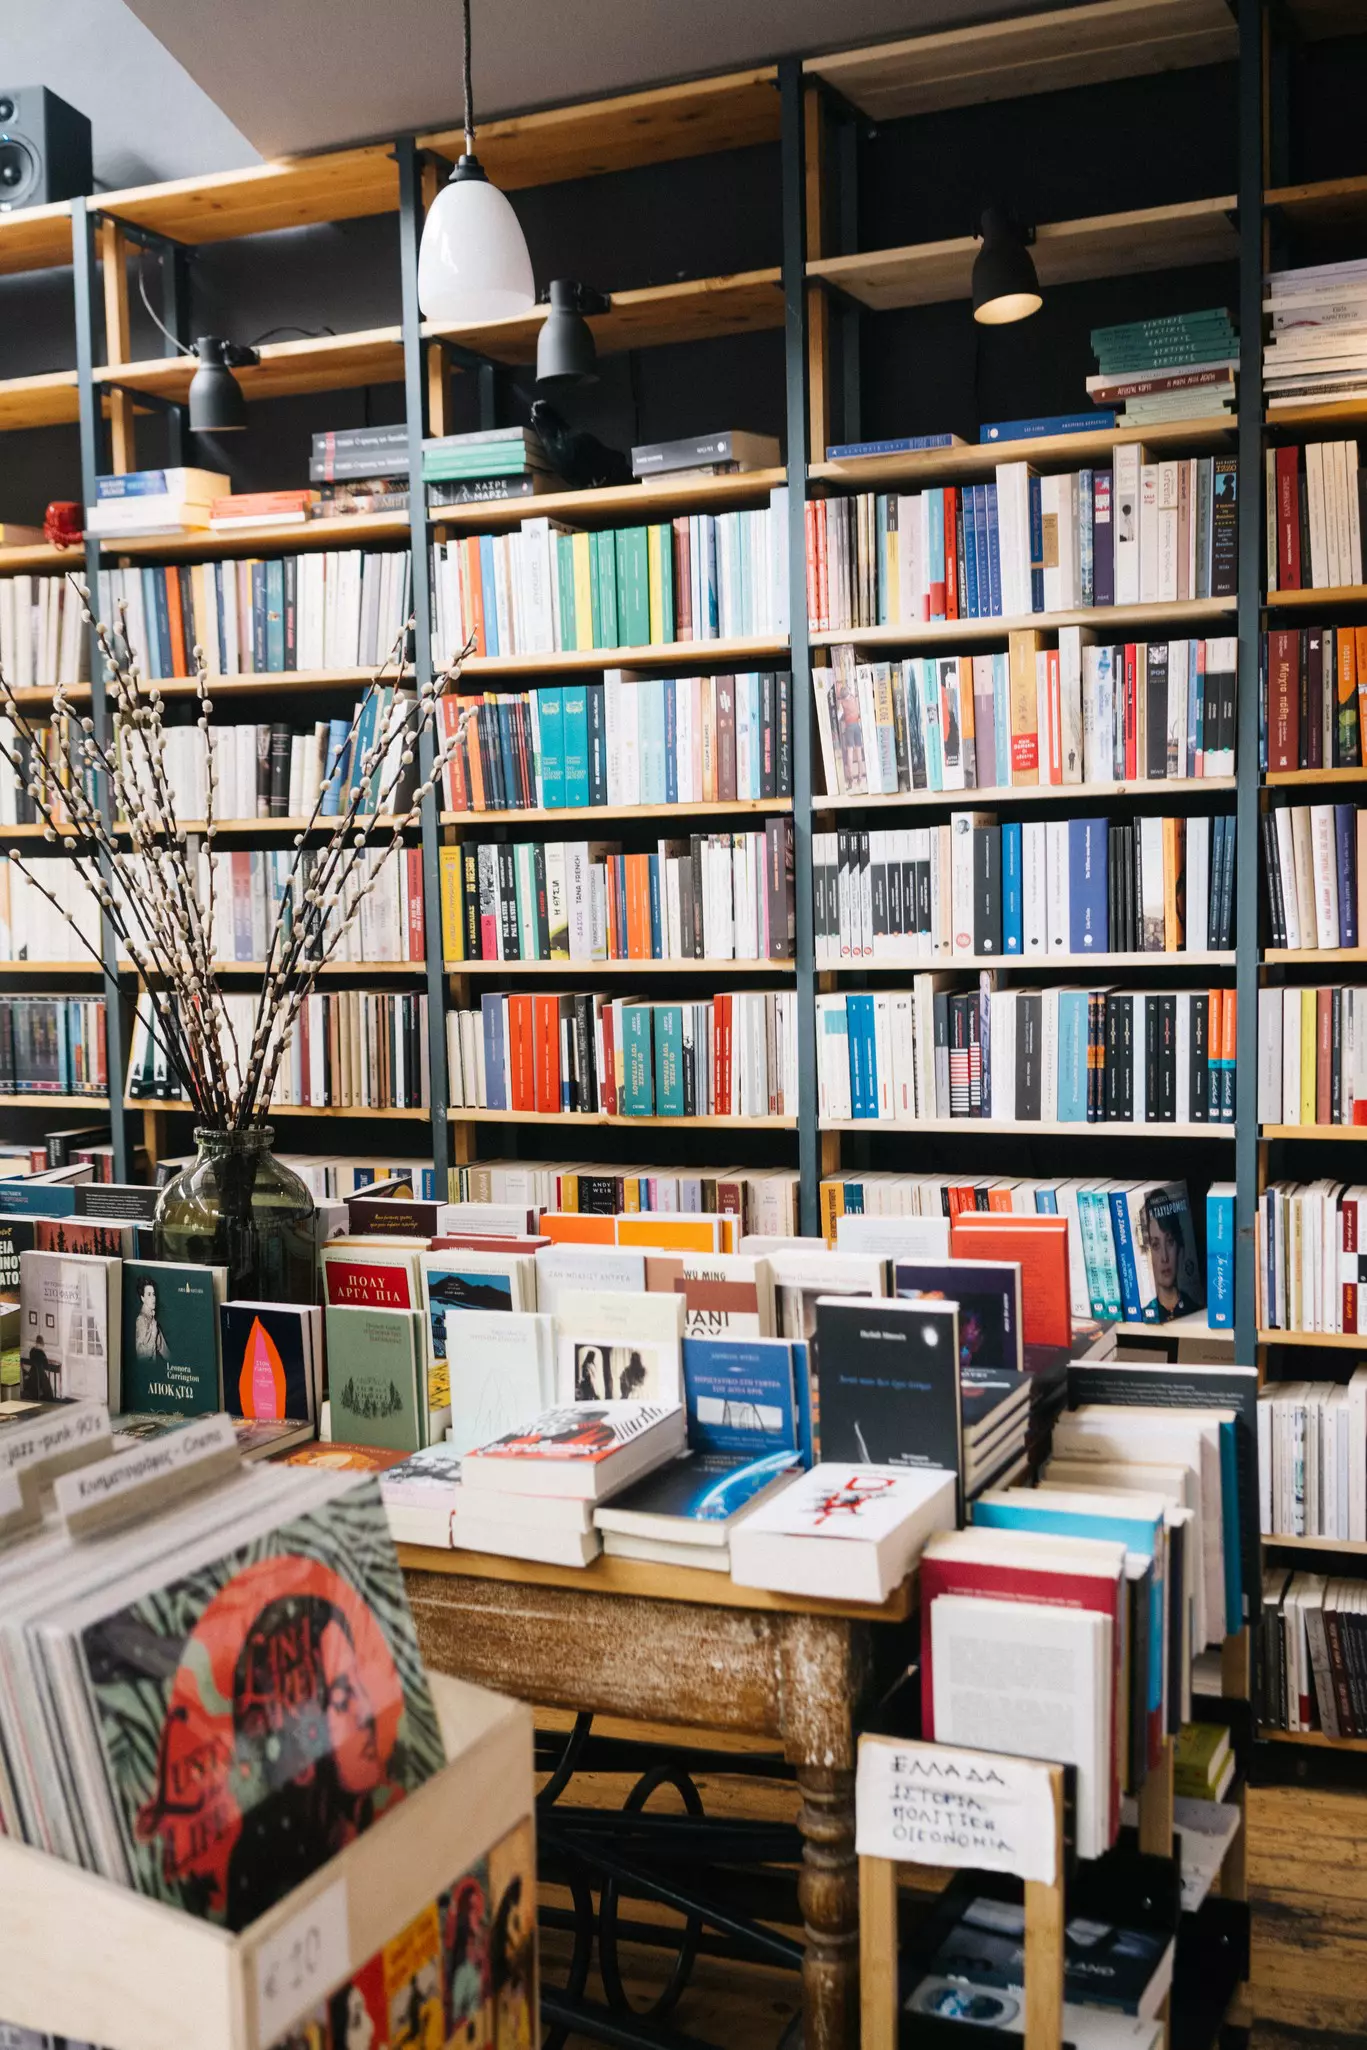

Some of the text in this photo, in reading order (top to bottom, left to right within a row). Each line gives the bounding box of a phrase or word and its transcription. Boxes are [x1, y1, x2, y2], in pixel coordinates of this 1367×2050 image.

[348, 1274, 386, 1288] ΠΟΛΥ
[702, 1271, 726, 1281] MING
[337, 1287, 401, 1302] ΑΡΓΑ ΠΙΑ
[166, 1362, 191, 1373] Leonora
[166, 1371, 200, 1383] Carrington
[147, 1382, 194, 1400] ΑΠΟΚΑΤΩ
[892, 1756, 1006, 1786] ΕΛΛΑΔΑ
[890, 1784, 985, 1812] ΙΣΤΟΡΙΑ
[893, 1804, 996, 1832] ΠΟΛΙΤΙΚΗ
[893, 1825, 1015, 1853] ΟΙΚΟΝΟΜΙΑ
